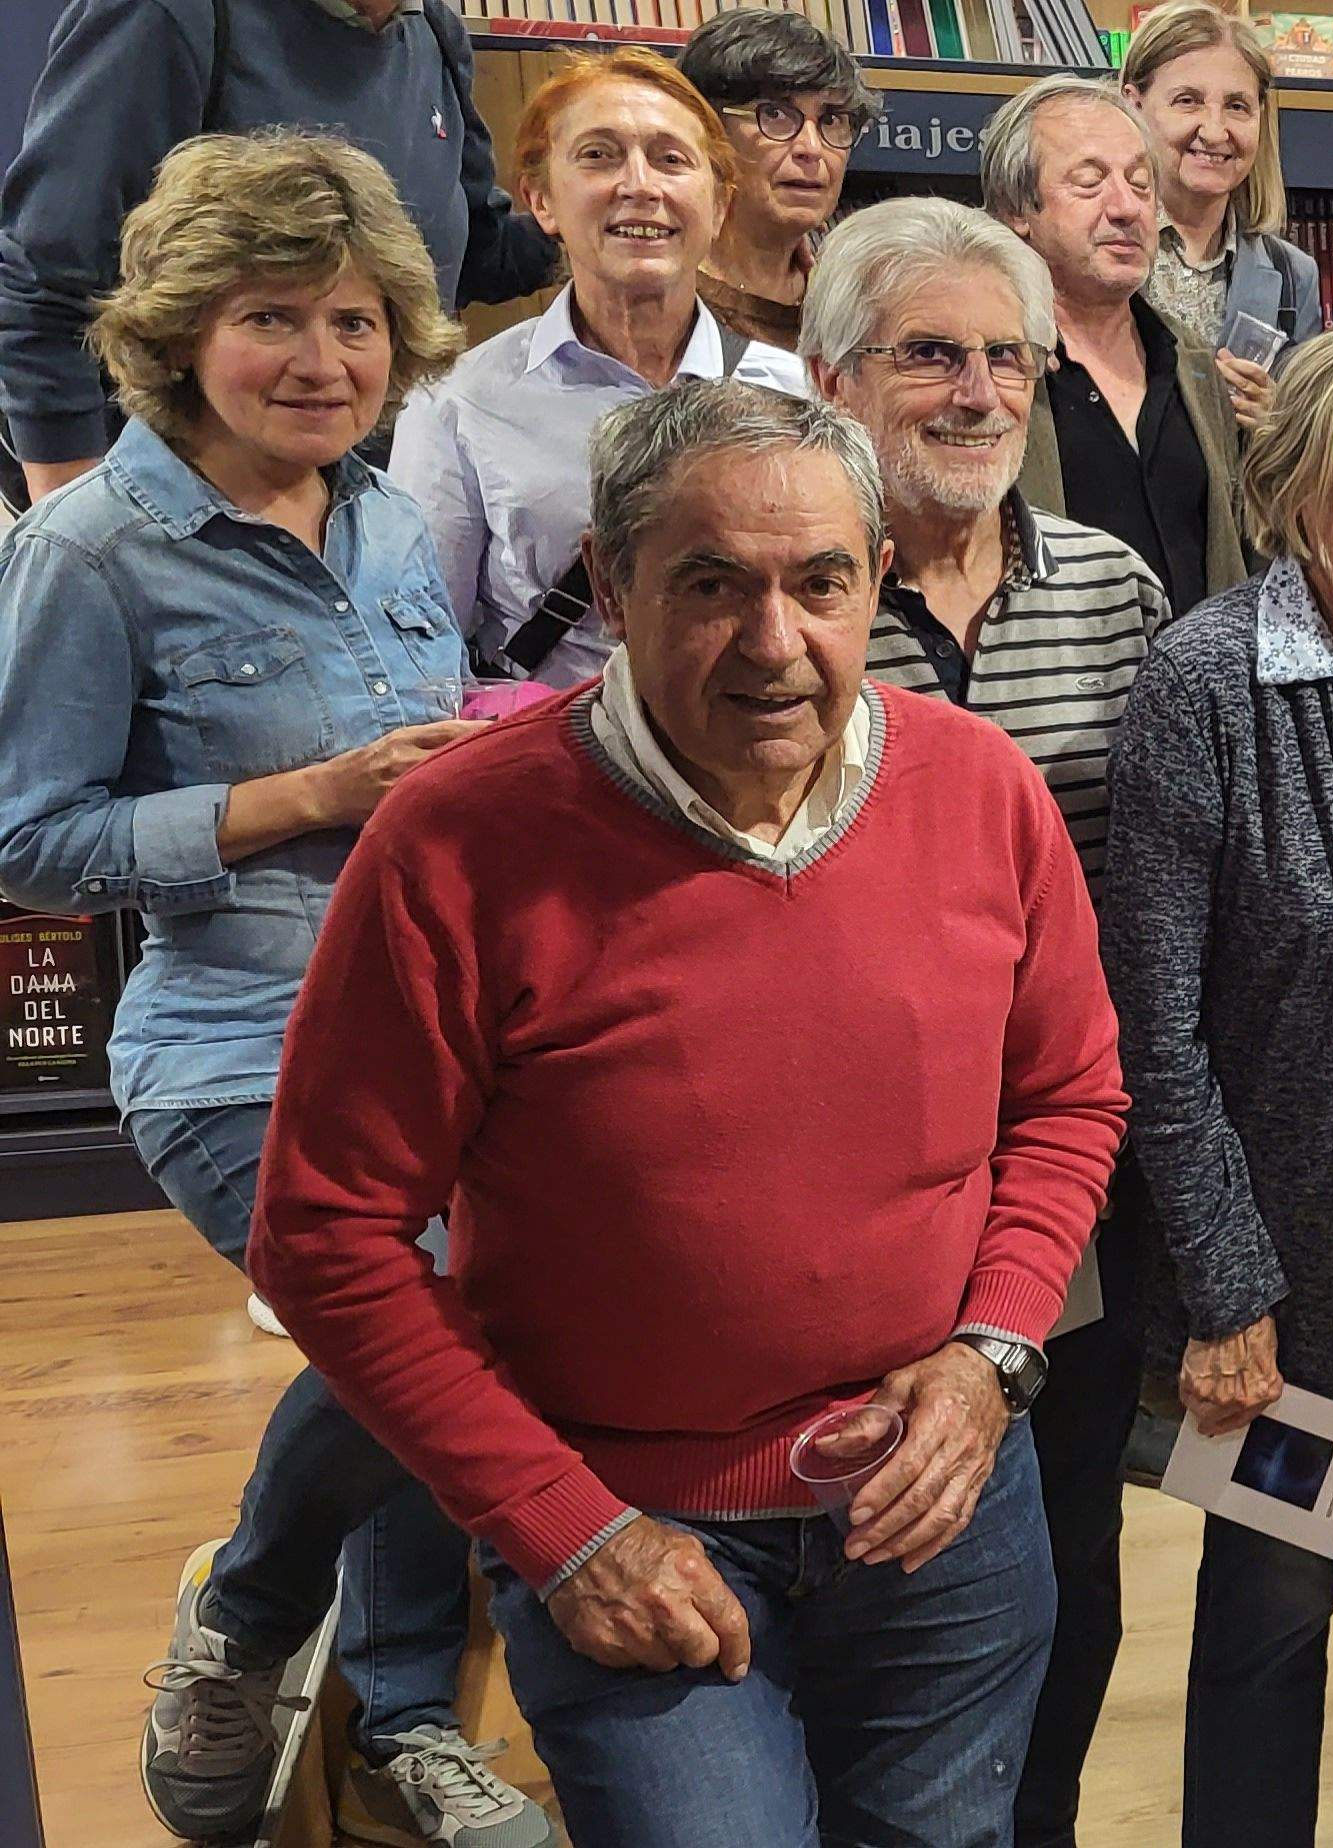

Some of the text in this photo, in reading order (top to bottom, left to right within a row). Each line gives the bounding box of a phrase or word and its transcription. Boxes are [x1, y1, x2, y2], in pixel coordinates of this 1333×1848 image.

[854, 115, 986, 158] iaje
[28, 947, 56, 968] LA
[10, 972, 77, 995] DAMA
[24, 999, 67, 1021] DEL
[9, 1025, 85, 1049] NORTE
